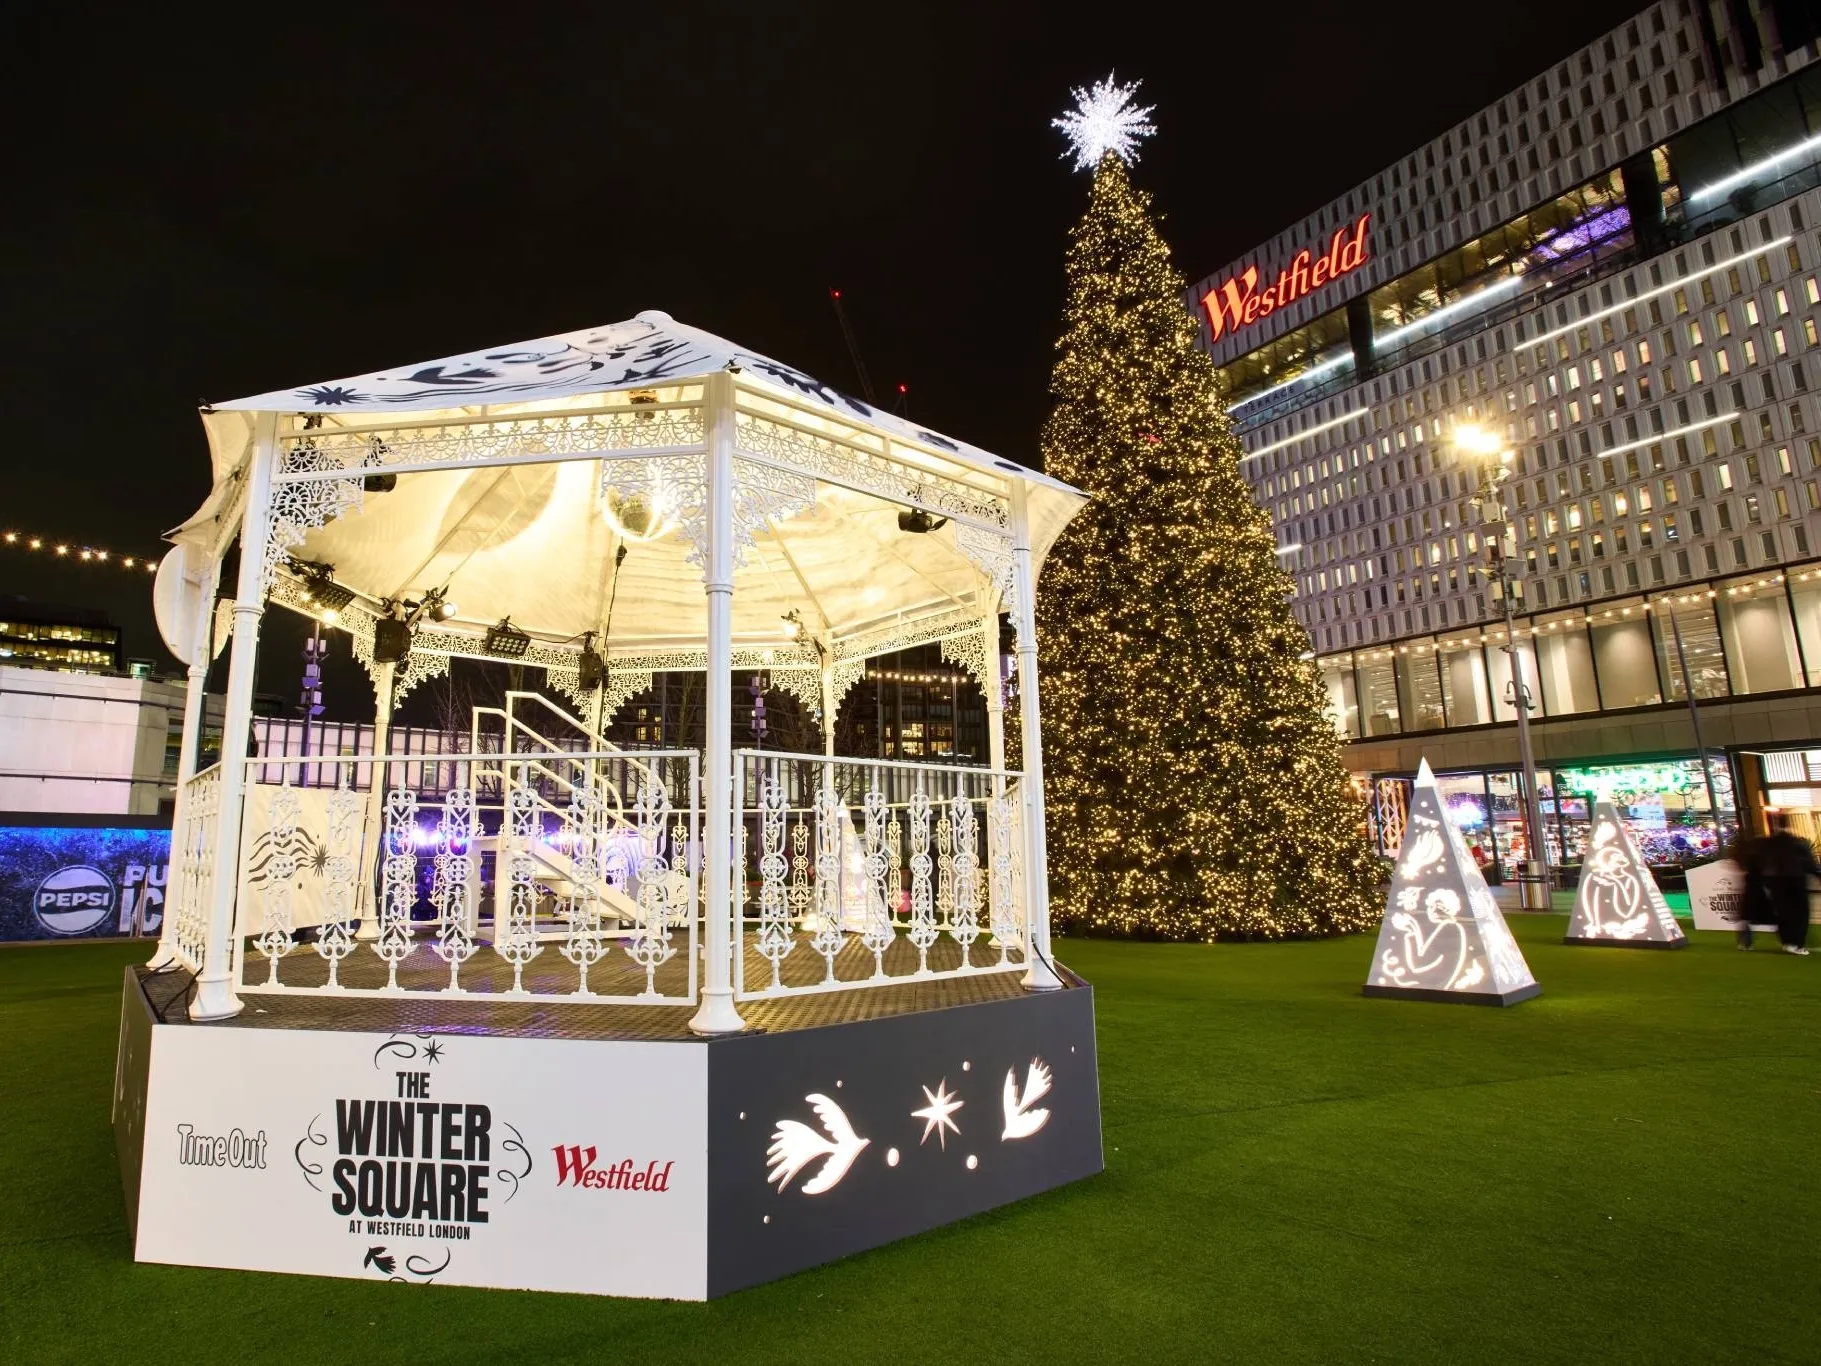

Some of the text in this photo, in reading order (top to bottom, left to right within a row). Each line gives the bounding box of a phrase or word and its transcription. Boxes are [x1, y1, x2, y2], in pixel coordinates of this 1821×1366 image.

[1202, 213, 1370, 343] Westfield
[123, 865, 169, 887] PU
[40, 892, 110, 907] PEPSI
[119, 888, 164, 932] IC
[396, 1071, 430, 1098] THE
[335, 1099, 492, 1161] WINTER
[551, 1144, 675, 1192] Westfield
[331, 1158, 490, 1223] SQUARE
[349, 1220, 471, 1240] AT WESTFIELD LONDON
